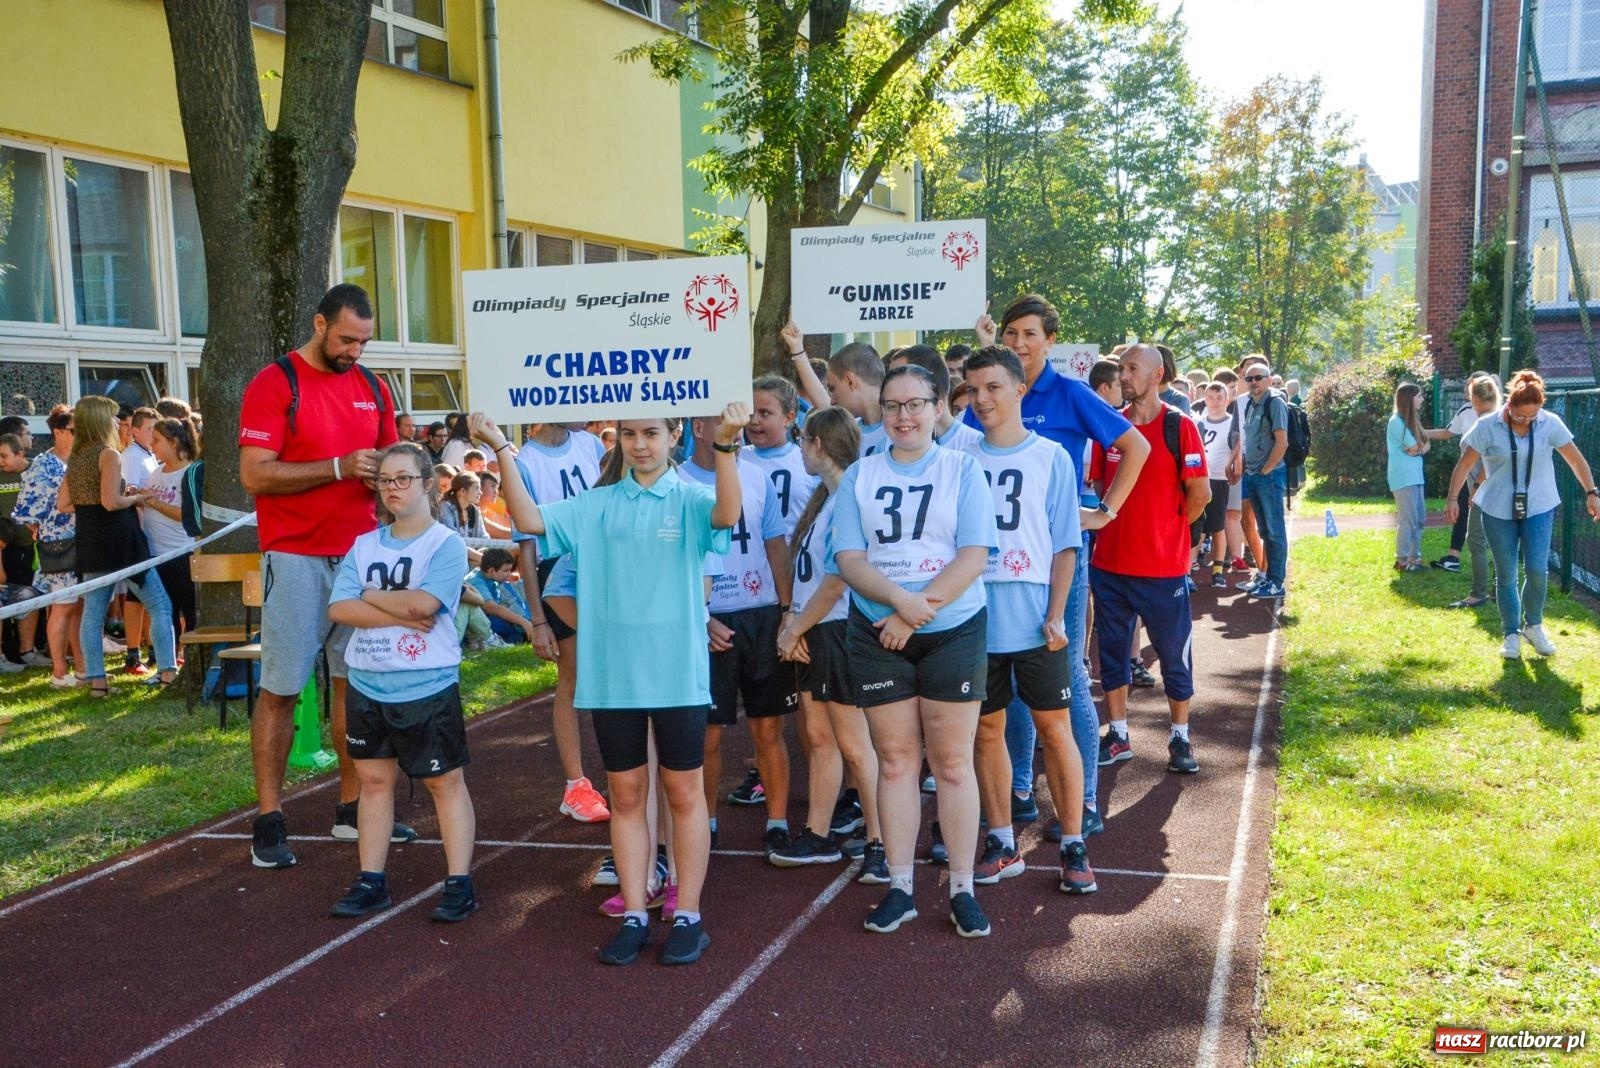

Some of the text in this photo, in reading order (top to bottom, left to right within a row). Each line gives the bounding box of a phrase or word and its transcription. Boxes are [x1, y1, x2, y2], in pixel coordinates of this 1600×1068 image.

[800, 231, 935, 247] Olimpiady Specjalne
[906, 246, 935, 257] Śląskie
[472, 291, 670, 314] Olimpiady Specjalne
[629, 312, 671, 329] Śląskie
[859, 305, 914, 321] ZABRZE
[508, 377, 709, 408] WODZISŁAW ŚLĄSKI
[875, 483, 934, 545] 37
[862, 680, 894, 691] GIVOVA
[961, 682, 970, 694] 6
[785, 693, 798, 706] 17
[430, 759, 440, 771] 2
